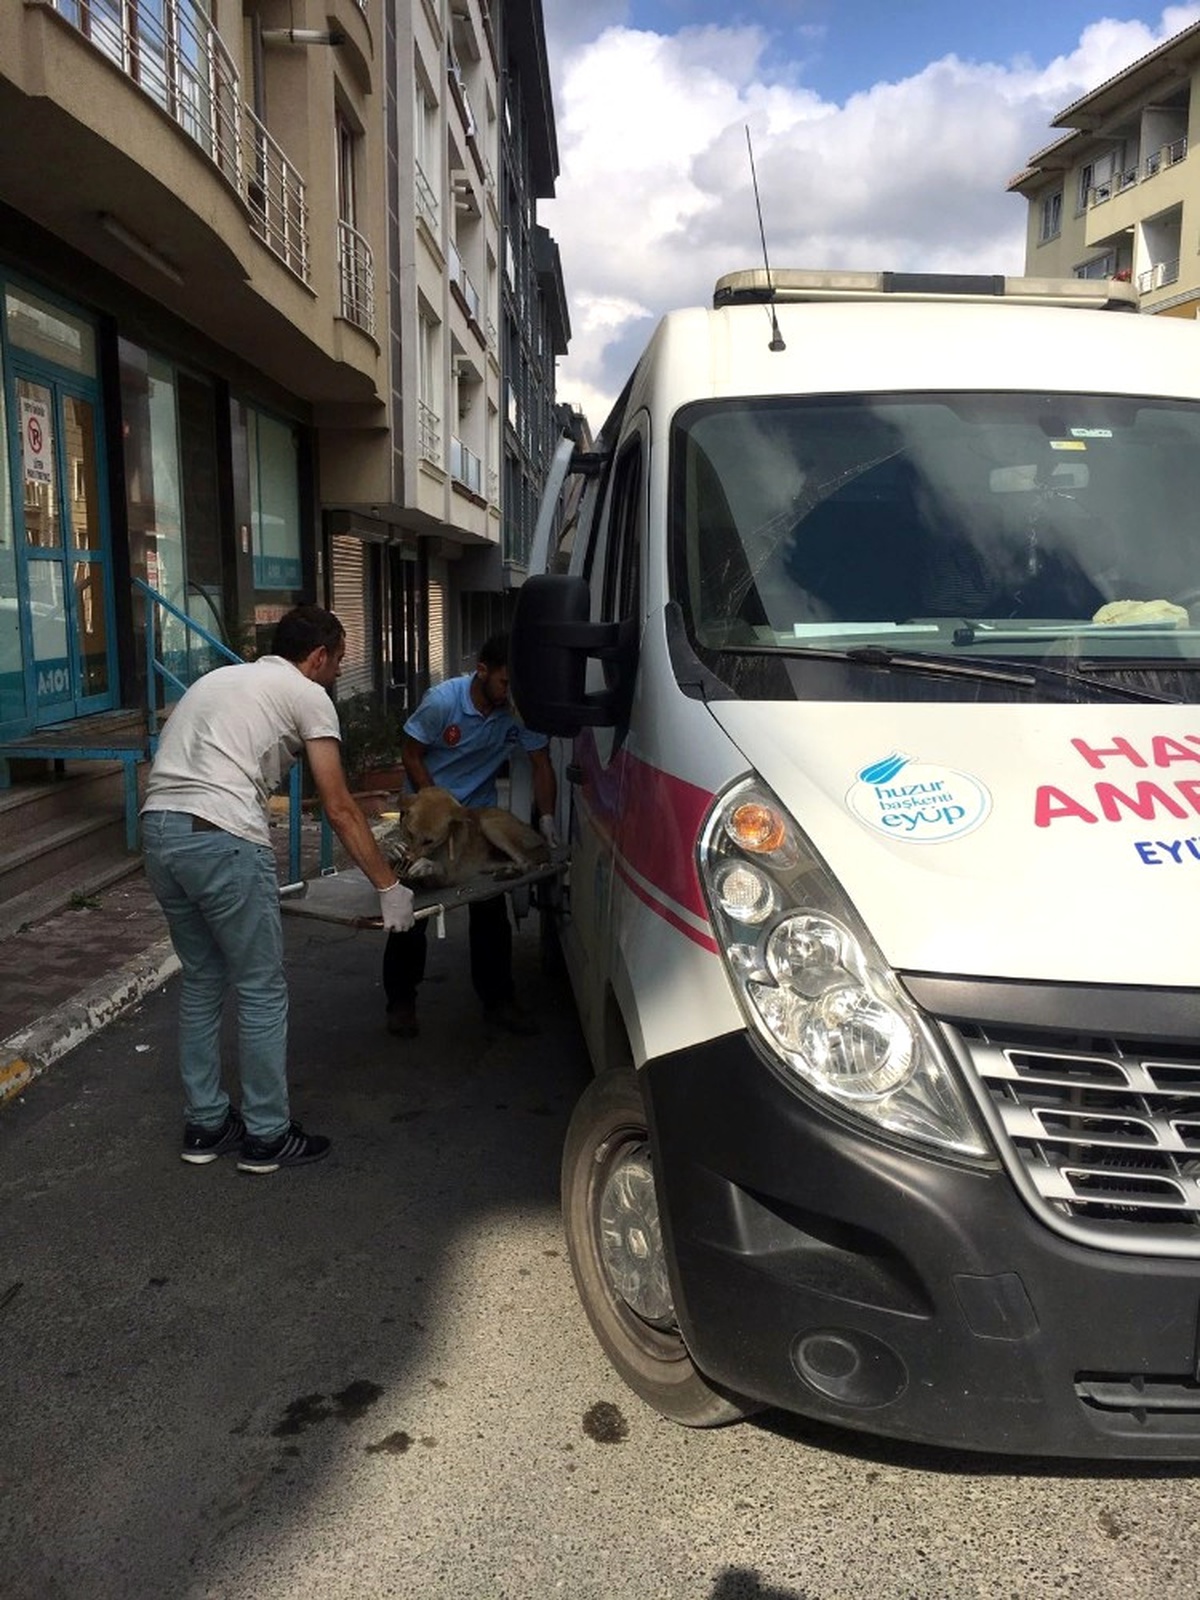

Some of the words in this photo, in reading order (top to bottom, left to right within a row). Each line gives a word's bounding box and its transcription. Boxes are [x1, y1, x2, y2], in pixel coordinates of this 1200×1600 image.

[875, 780, 945, 800] huzur
[879, 793, 954, 811] başkenti
[881, 805, 965, 831] eyüp
